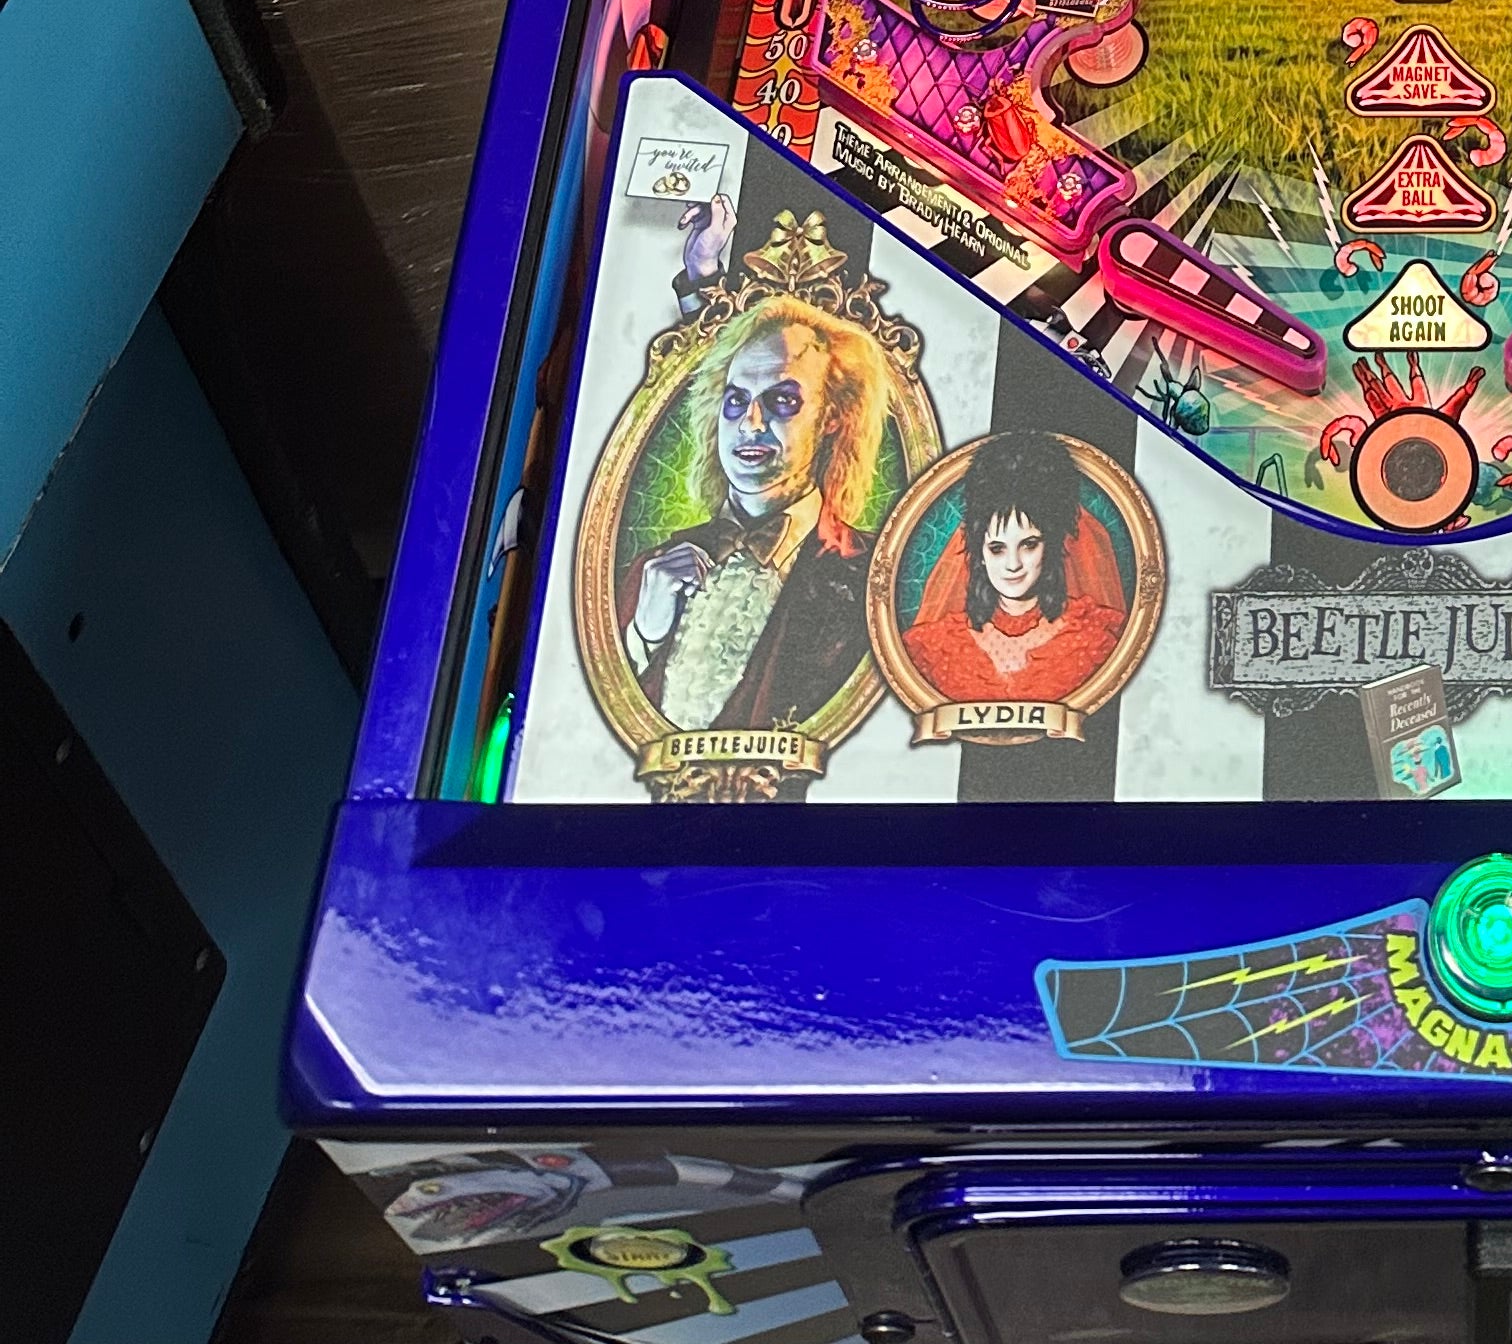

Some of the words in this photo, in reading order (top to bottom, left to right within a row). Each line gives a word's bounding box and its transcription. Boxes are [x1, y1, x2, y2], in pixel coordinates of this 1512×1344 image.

[764, 32, 809, 61] 50
[1392, 65, 1453, 84] MAGNET
[756, 78, 802, 106] 40
[1402, 83, 1439, 101] SAVE
[639, 147, 693, 167] you're
[664, 155, 723, 173] invited
[1398, 171, 1443, 190] EXTRA
[834, 144, 875, 181] MUSIC
[878, 175, 896, 194] BY
[898, 182, 945, 229] BRADY
[944, 221, 987, 258] HEARN
[836, 123, 871, 159] THEME
[874, 151, 959, 220] ARRANGEMENT
[975, 220, 1031, 266] ORIGINAL
[1401, 189, 1438, 209] BALL
[1389, 294, 1446, 317] SHOOT
[1389, 320, 1447, 344] AGAIN
[957, 705, 1047, 726] LYDIA
[1390, 693, 1432, 717] Recently
[1391, 702, 1437, 732] Deceased
[669, 735, 801, 759] BEETLEJUICE
